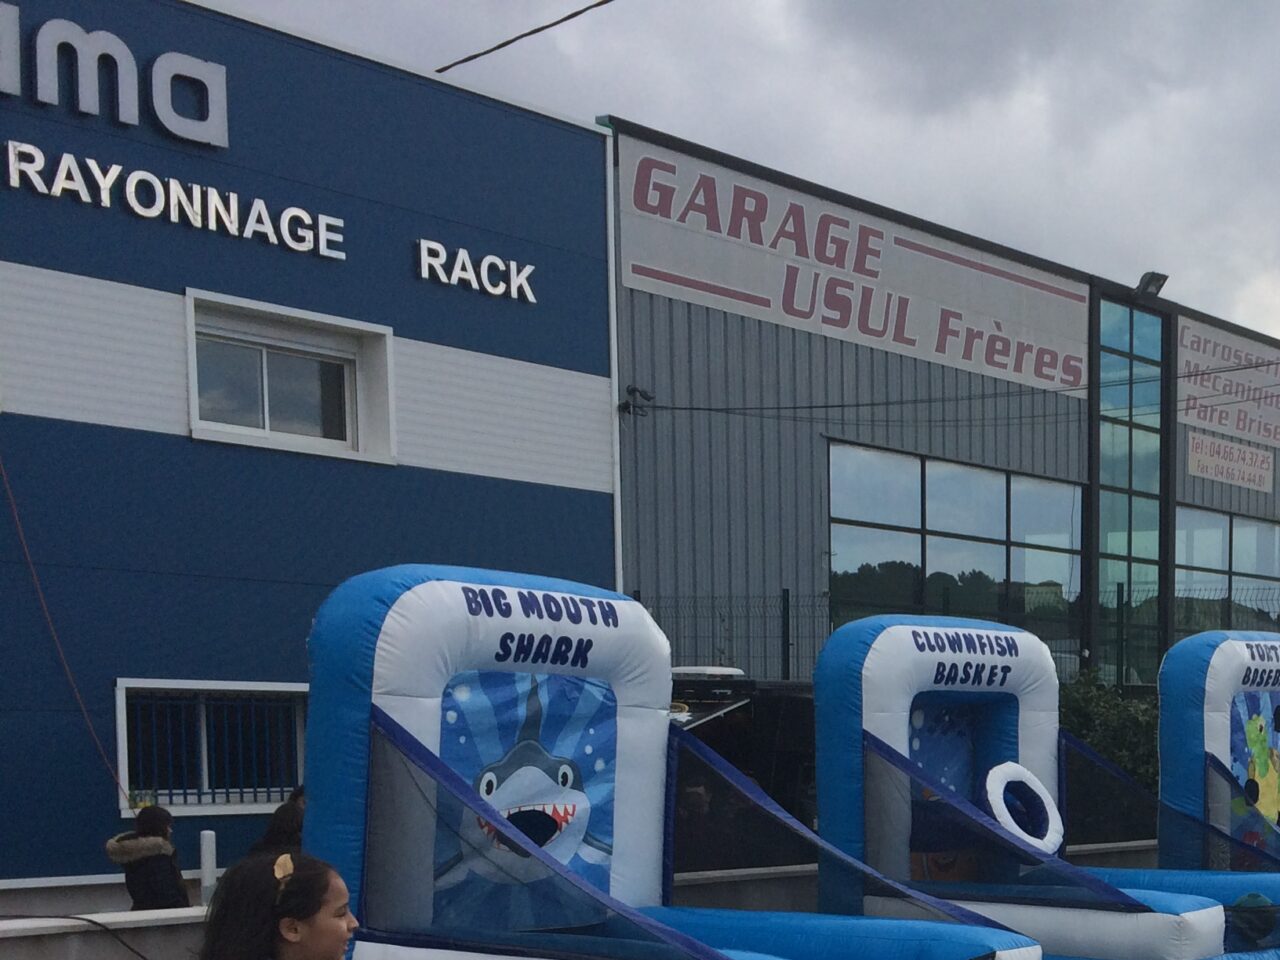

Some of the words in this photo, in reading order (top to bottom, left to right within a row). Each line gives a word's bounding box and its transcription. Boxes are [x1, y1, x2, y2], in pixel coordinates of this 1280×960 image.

[7, 140, 347, 260] RAYONNAGE
[419, 239, 538, 303] RACK
[632, 155, 884, 279] GARAGE
[781, 264, 917, 347] USUL
[934, 307, 1084, 388] Frères
[1184, 393, 1229, 427] Pare
[462, 586, 512, 618] BIG
[517, 590, 619, 628] MOUTH
[494, 632, 594, 669] SHARK
[911, 629, 1020, 658] CLOWNFISH
[933, 661, 1012, 687] BASKET
